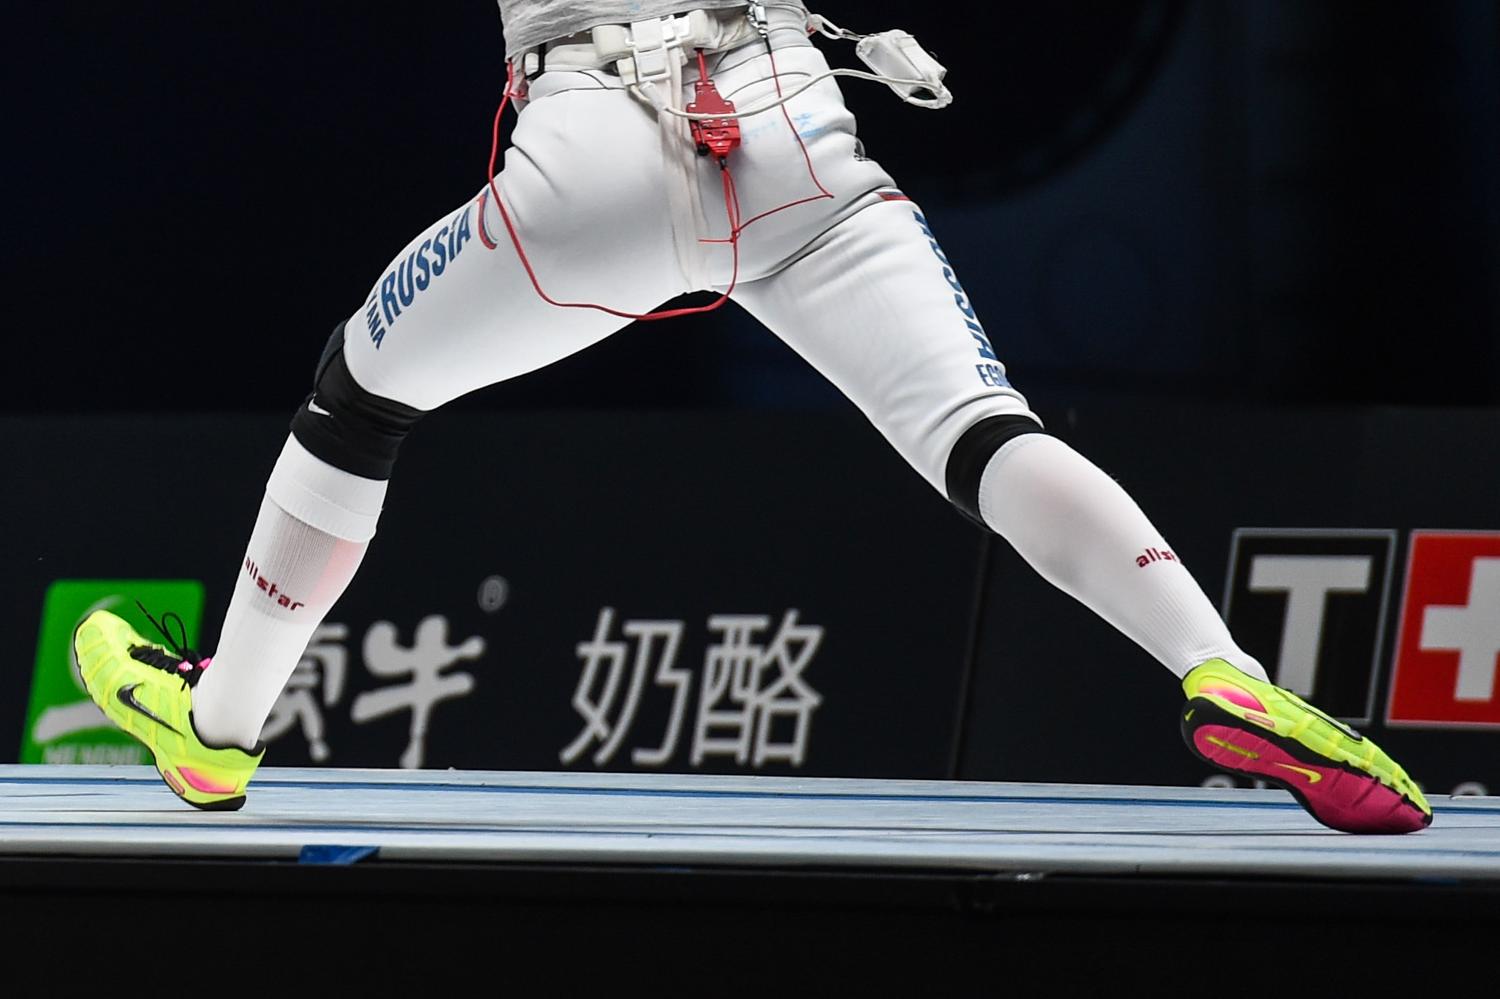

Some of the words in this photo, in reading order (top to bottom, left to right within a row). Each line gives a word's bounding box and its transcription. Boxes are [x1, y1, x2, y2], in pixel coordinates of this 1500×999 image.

[380, 205, 472, 327] RUSSIA
[245, 556, 305, 611] allstar
[558, 606, 825, 768] 奶酪
